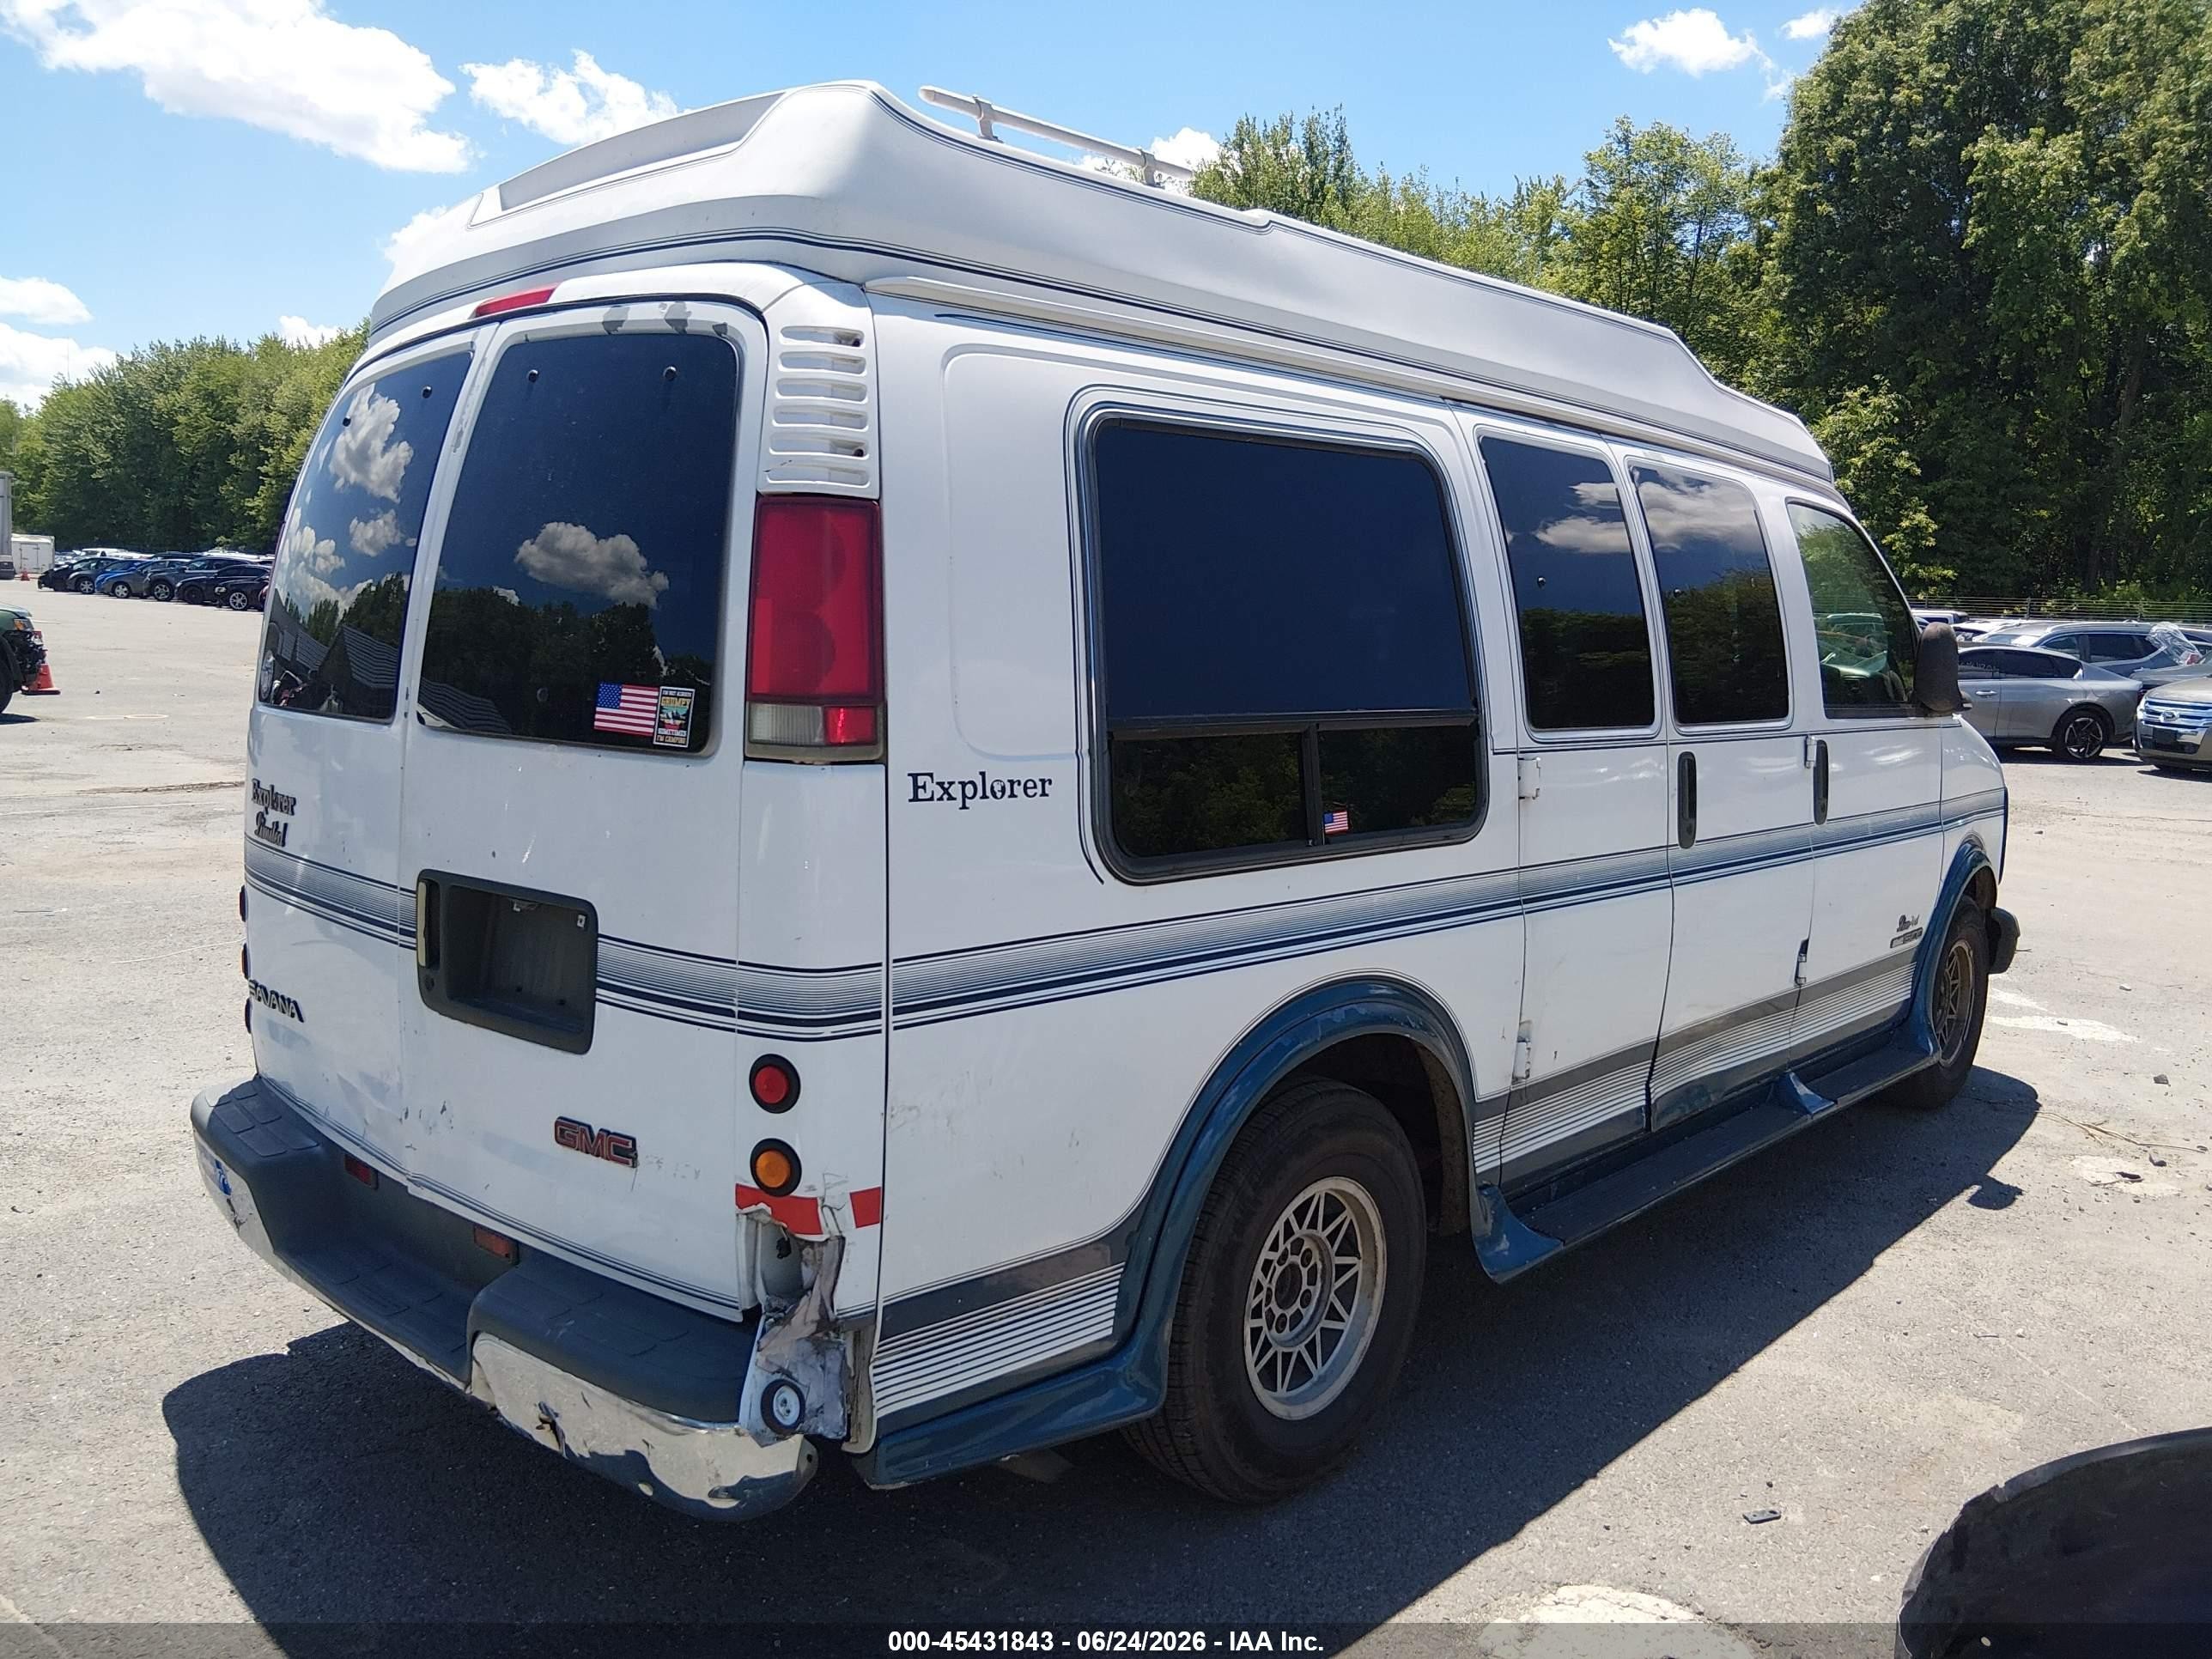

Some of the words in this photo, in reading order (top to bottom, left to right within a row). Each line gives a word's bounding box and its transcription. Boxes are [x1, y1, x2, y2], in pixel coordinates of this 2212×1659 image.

[252, 778, 296, 816] Explorer
[908, 771, 1053, 810] Explorer
[555, 1116, 638, 1168] GMC
